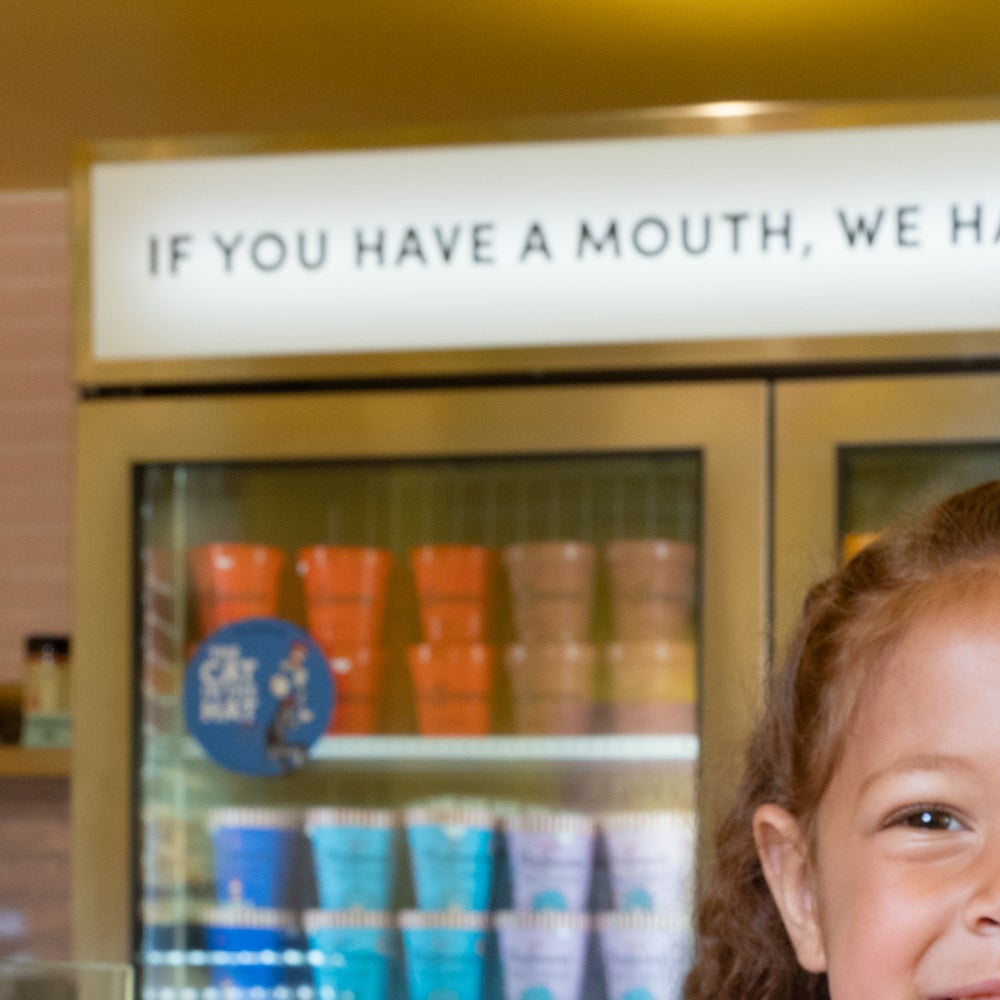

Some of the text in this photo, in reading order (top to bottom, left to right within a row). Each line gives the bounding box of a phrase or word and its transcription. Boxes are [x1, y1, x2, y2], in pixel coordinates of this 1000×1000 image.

[147, 234, 192, 277] IF
[212, 230, 329, 275] YOU
[353, 222, 495, 269] HAVE
[518, 220, 554, 262] A
[575, 211, 812, 261] MOUTH,
[834, 204, 921, 249] WE
